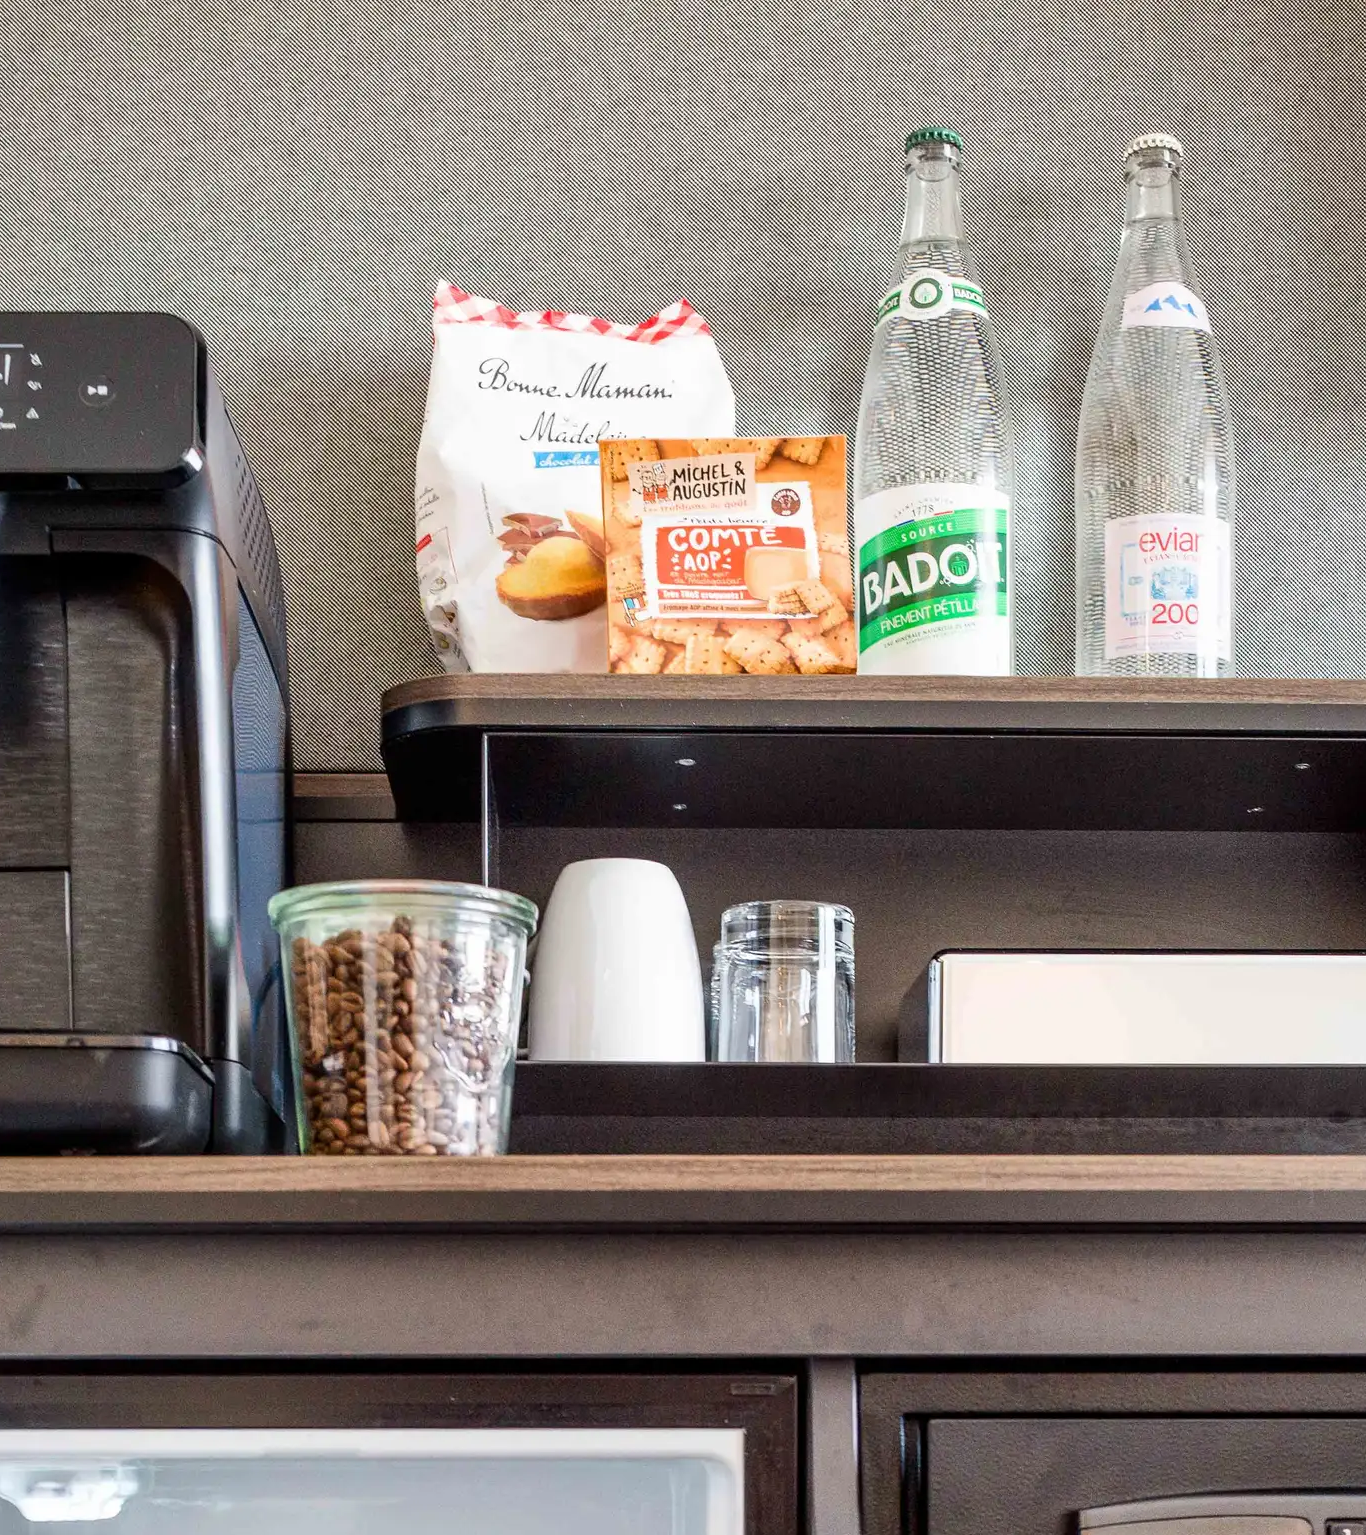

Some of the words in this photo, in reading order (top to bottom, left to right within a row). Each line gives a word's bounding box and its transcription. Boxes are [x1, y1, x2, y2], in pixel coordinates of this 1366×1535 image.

[478, 357, 561, 398] Bonne
[565, 362, 673, 399] Maman
[735, 460, 746, 475] &
[901, 522, 954, 543] SOURCE
[683, 552, 721, 572] AOP
[880, 606, 932, 634] FINEMENT
